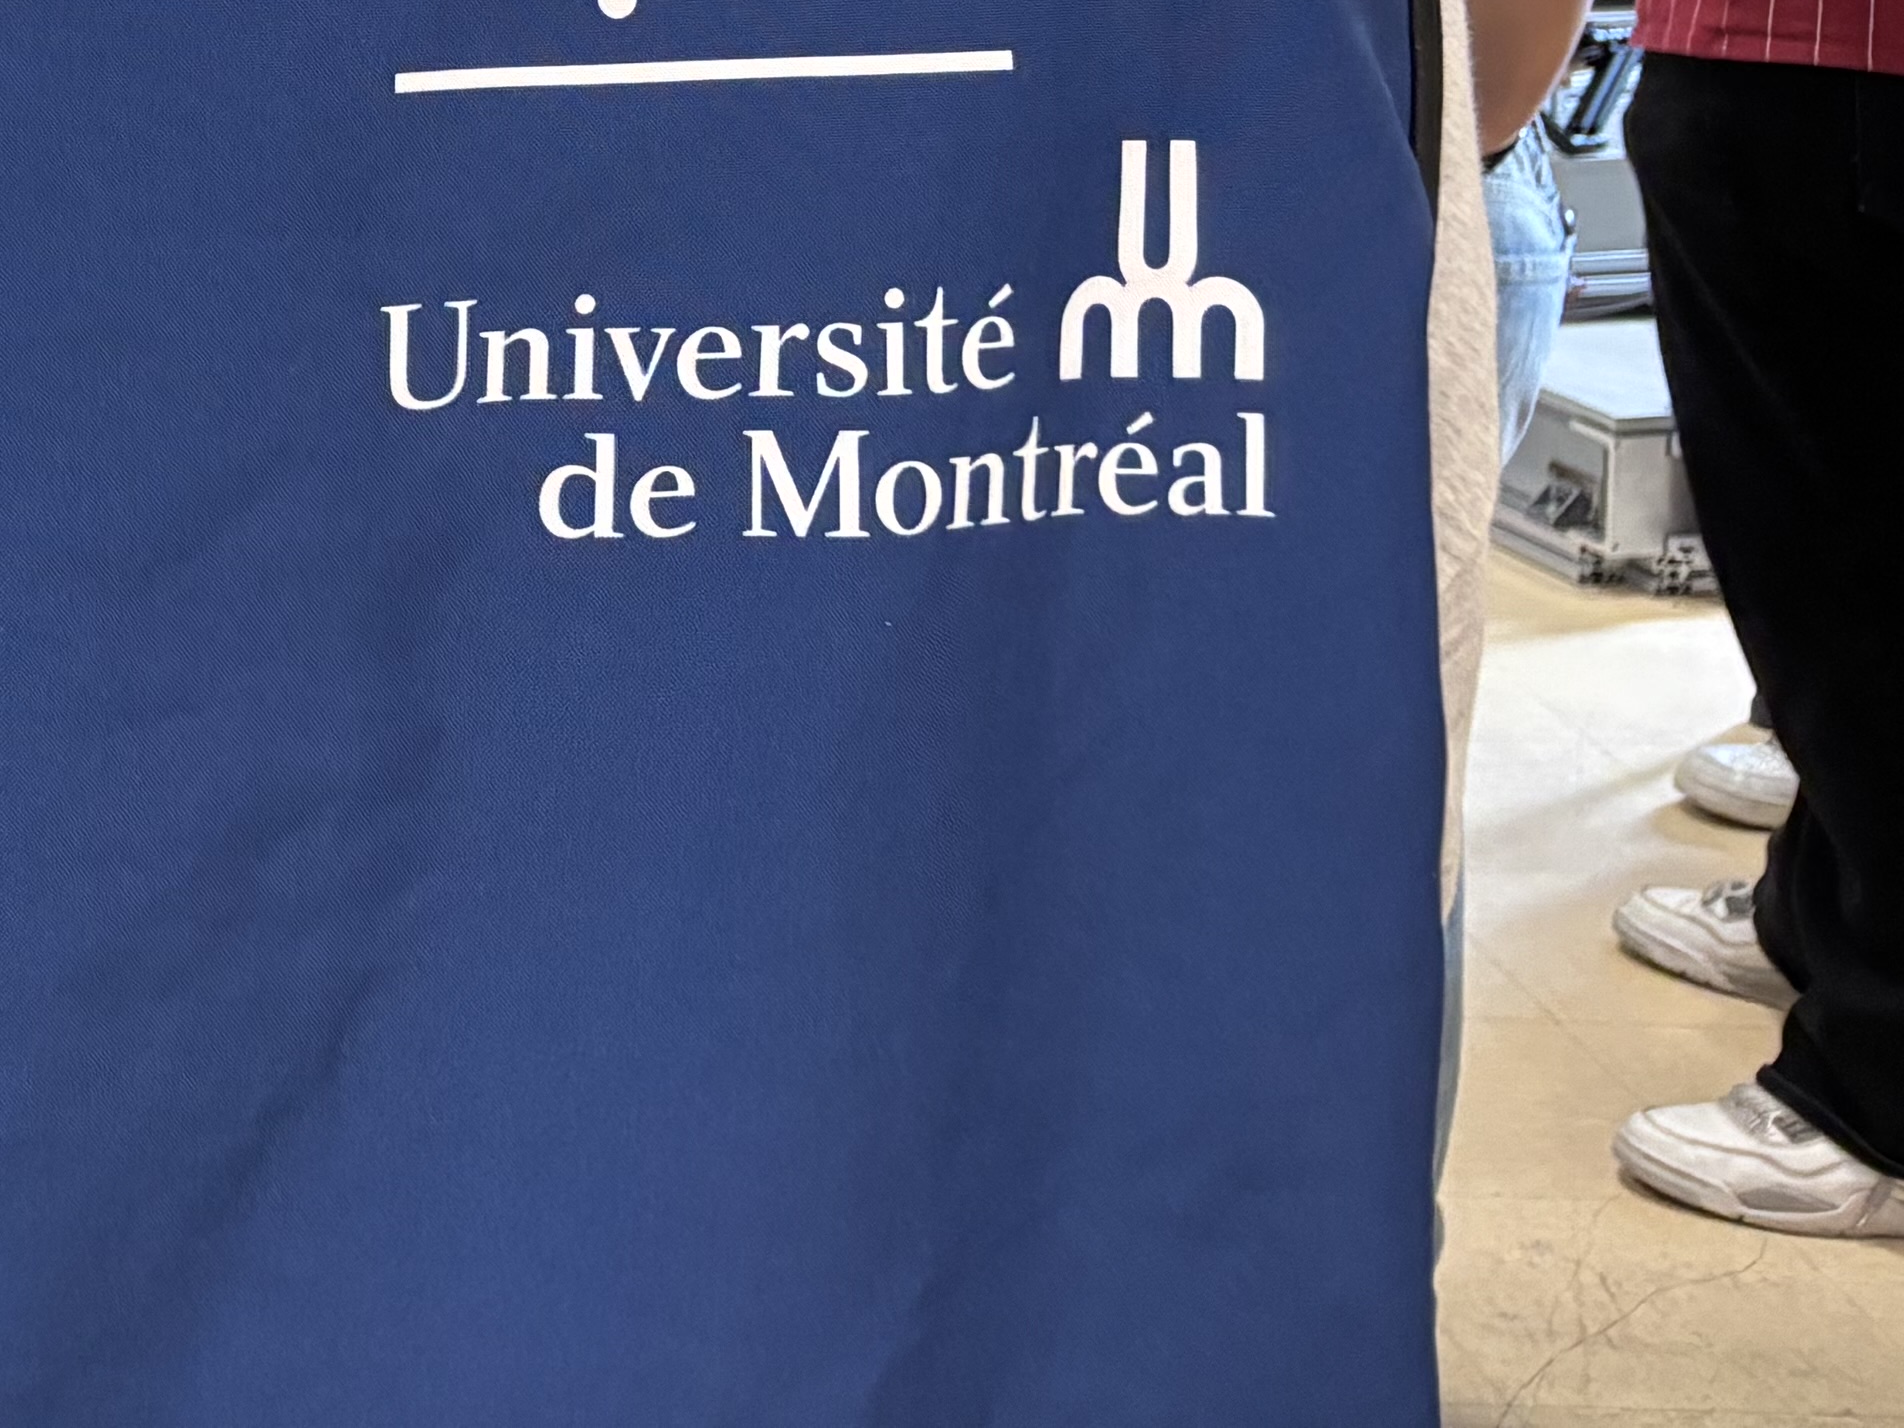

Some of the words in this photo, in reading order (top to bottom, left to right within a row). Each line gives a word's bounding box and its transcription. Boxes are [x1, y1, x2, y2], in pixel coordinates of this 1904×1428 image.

[381, 284, 1015, 410] Université
[539, 433, 696, 539] de
[743, 412, 1275, 537] Montréal
